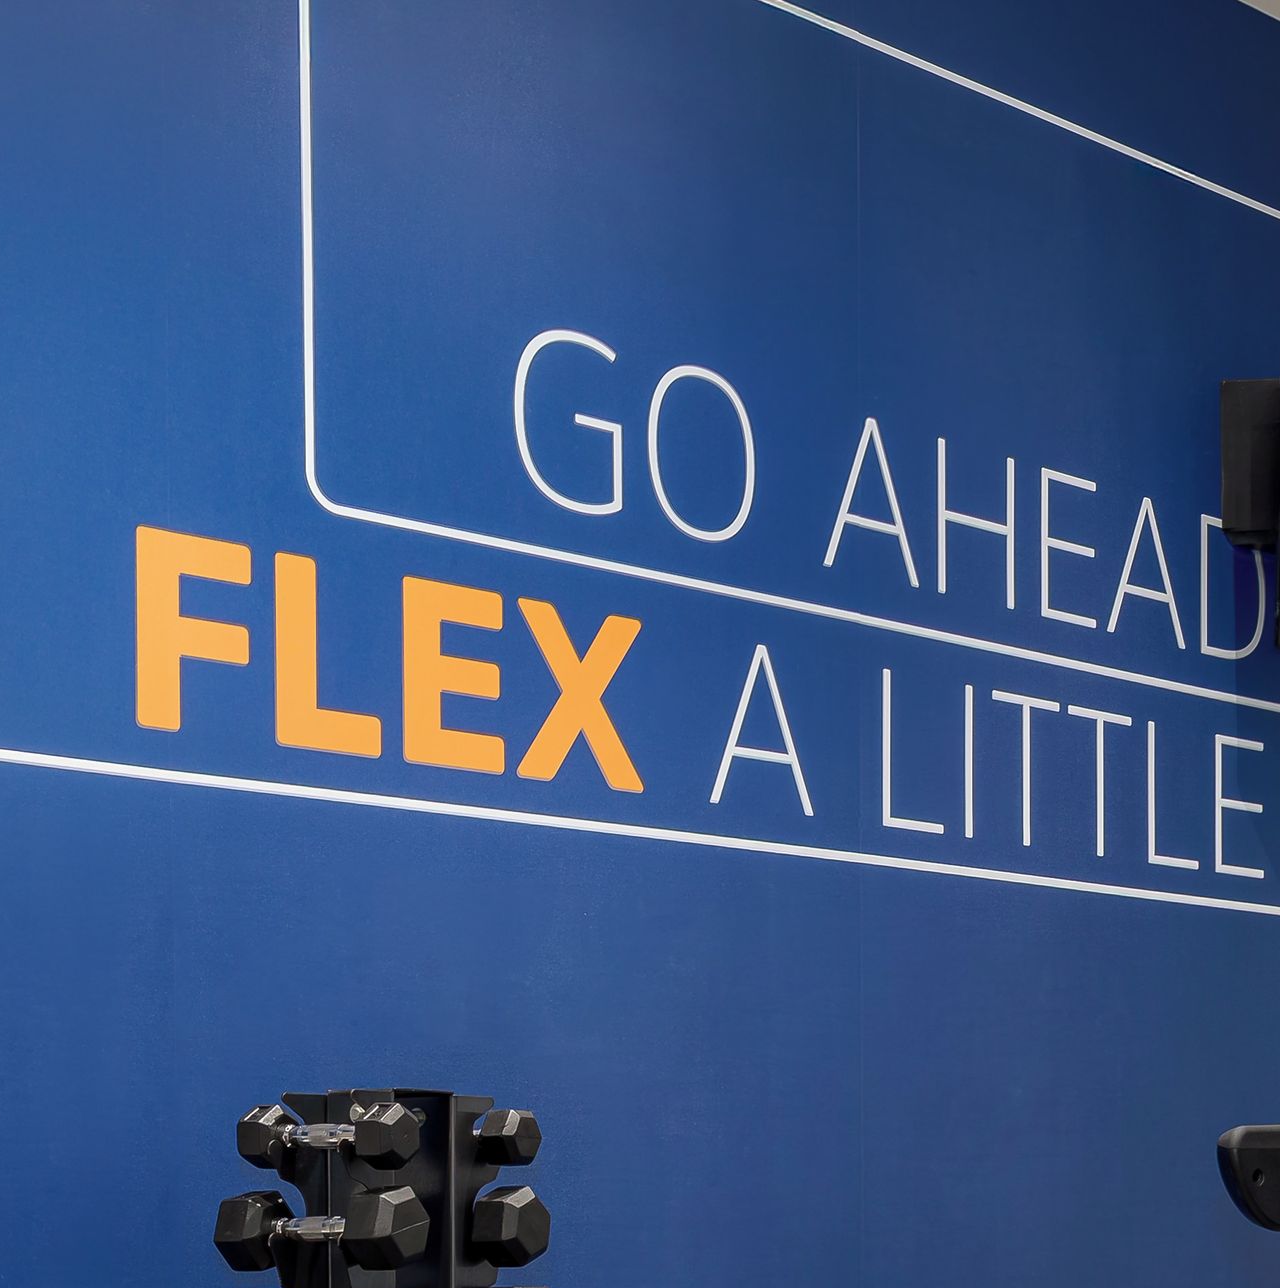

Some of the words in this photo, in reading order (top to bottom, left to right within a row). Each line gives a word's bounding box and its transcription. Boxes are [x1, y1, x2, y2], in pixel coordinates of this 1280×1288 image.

[513, 328, 756, 543] GO
[823, 416, 1266, 661] AHEAD
[134, 524, 645, 795] FLEX
[709, 644, 814, 818] A
[881, 667, 1266, 881] LITTLE
